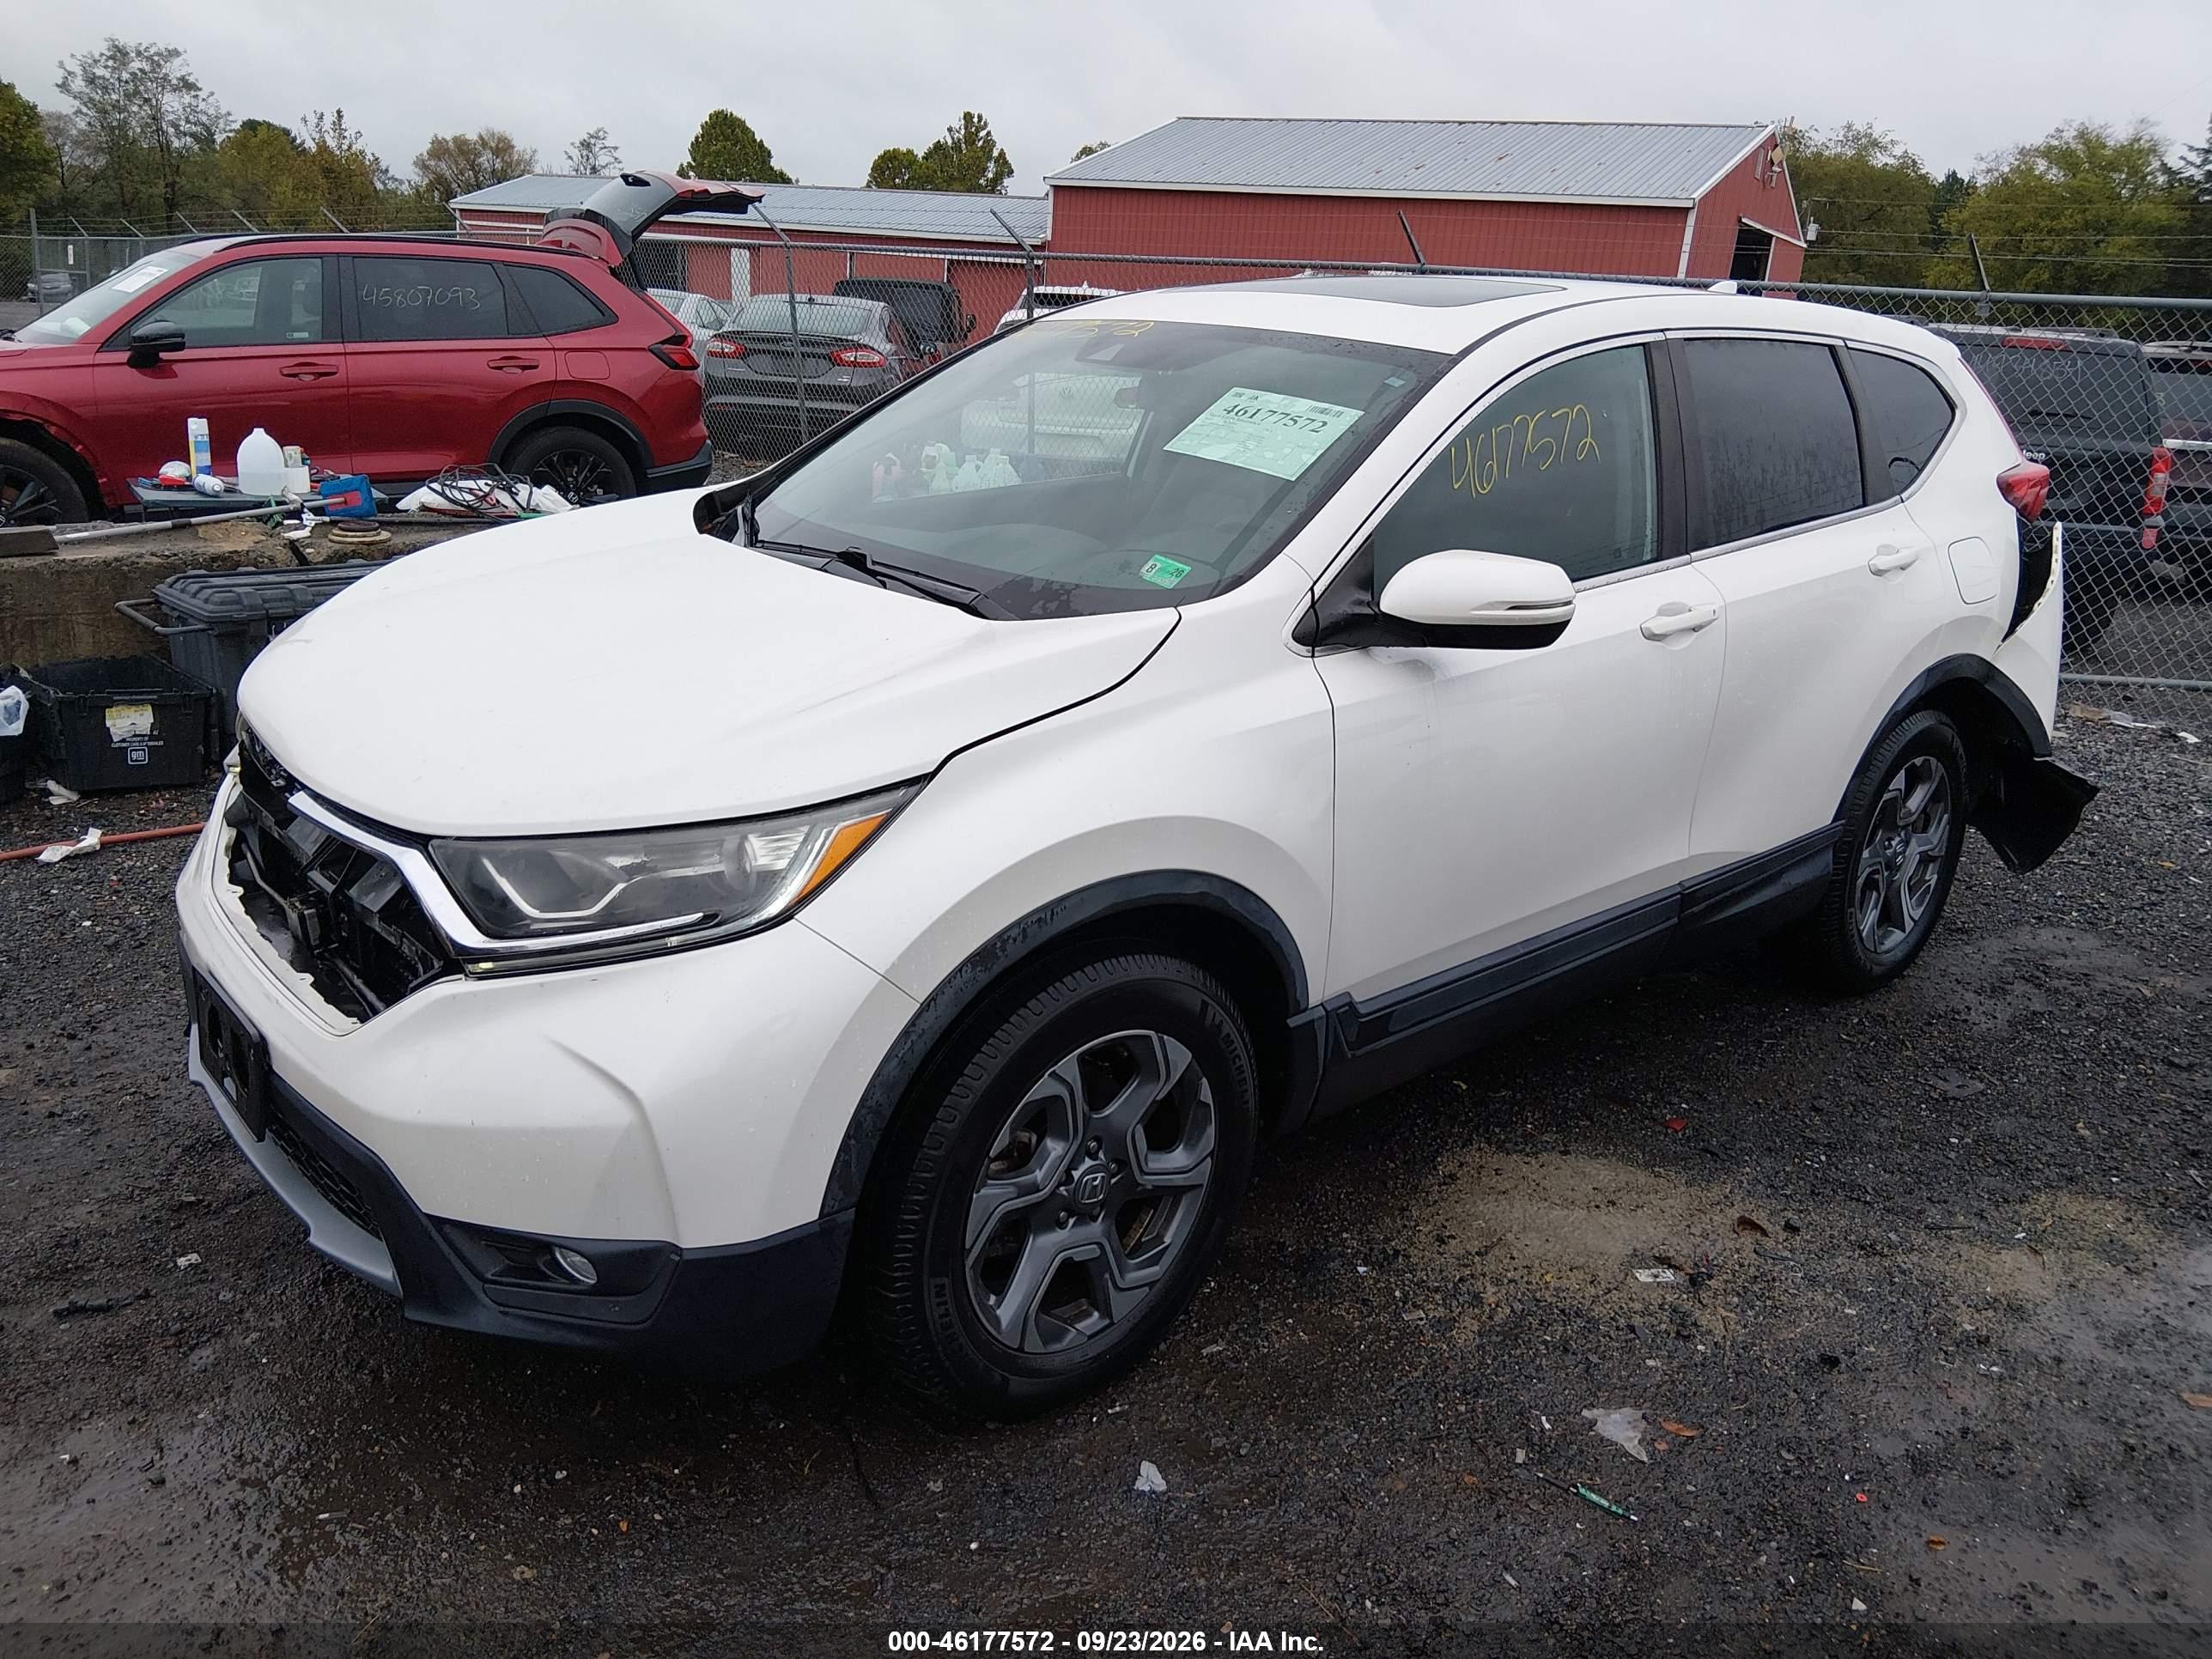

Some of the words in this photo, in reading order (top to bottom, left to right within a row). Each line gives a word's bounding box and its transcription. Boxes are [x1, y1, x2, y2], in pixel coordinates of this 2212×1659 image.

[362, 283, 481, 310] 45807093
[1223, 404, 1328, 434] 46177572
[1450, 404, 1601, 500] 46177572
[1146, 563, 1158, 574] 8
[131, 750, 145, 761] gm
